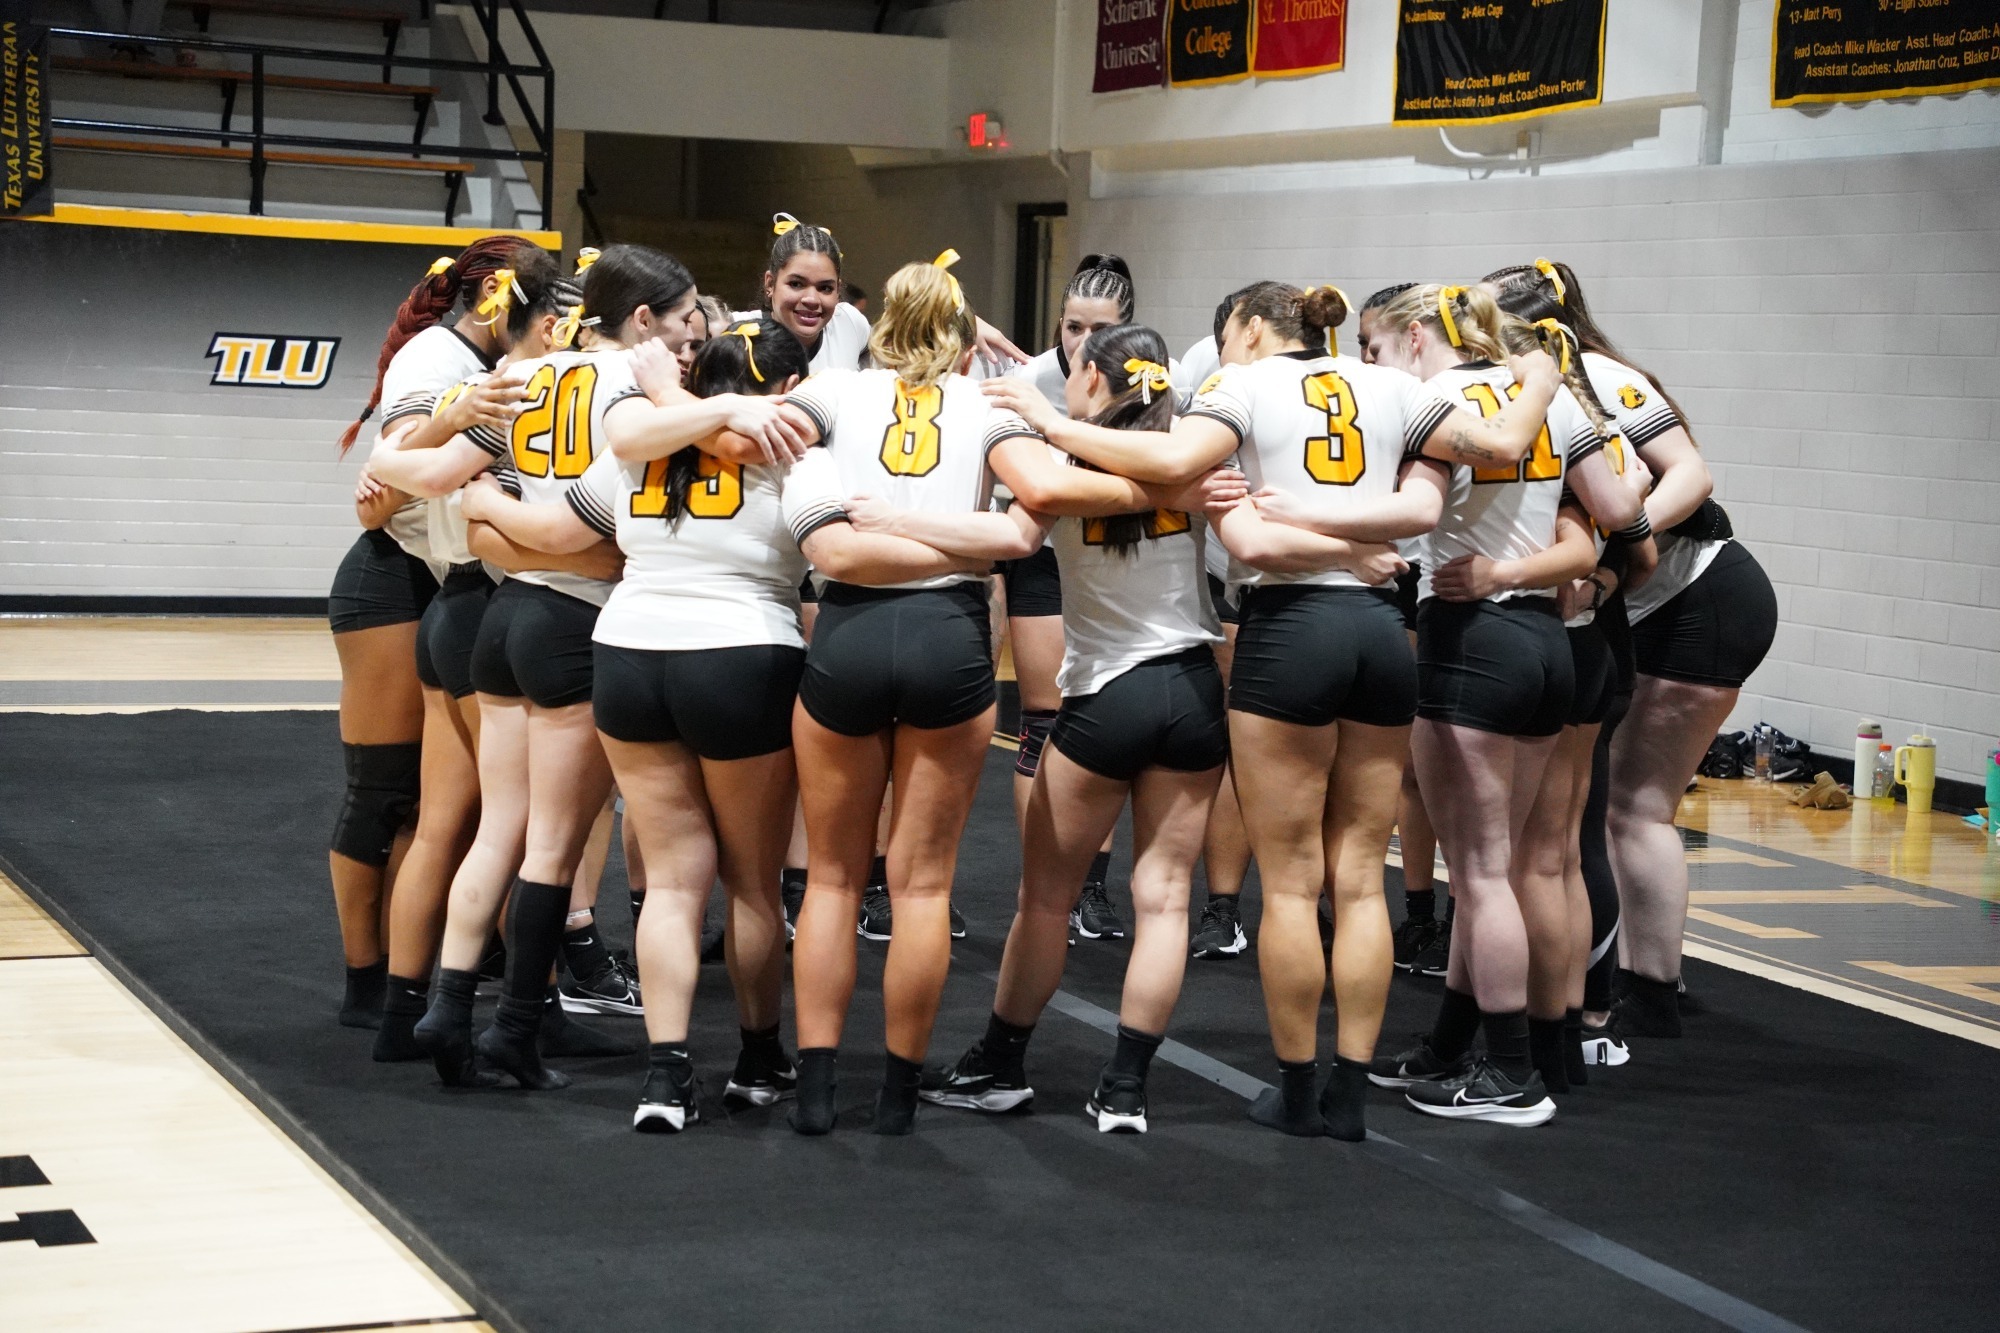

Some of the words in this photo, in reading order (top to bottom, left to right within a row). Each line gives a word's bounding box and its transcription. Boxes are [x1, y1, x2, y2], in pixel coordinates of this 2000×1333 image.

[1185, 25, 1232, 59] College
[1813, 41, 1843, 57] Coach:
[1844, 40, 1865, 55] Mike
[1866, 37, 1901, 54] Wacker
[1905, 35, 1931, 50] Asst.
[1933, 31, 1956, 47] Head
[1959, 25, 1991, 43] Coach:
[1822, 6, 1842, 22] Perry
[1, 21, 19, 139] LUTHERAN
[1498, 91, 1515, 105] Asst.
[1539, 82, 1559, 97] Steve
[1560, 79, 1587, 94] Porter
[1804, 62, 1849, 78] Assistant
[1851, 60, 1892, 77] Coaches:
[1893, 56, 1936, 74] Jonathan
[1937, 54, 1960, 70] Cruz,
[1963, 48, 1990, 66] Blake
[25, 49, 44, 181] UNIVERSITY
[3, 142, 22, 210] TEXAS
[206, 333, 341, 389] TLU
[511, 363, 599, 480] 20
[878, 375, 942, 478] 8
[1301, 370, 1367, 487] 3
